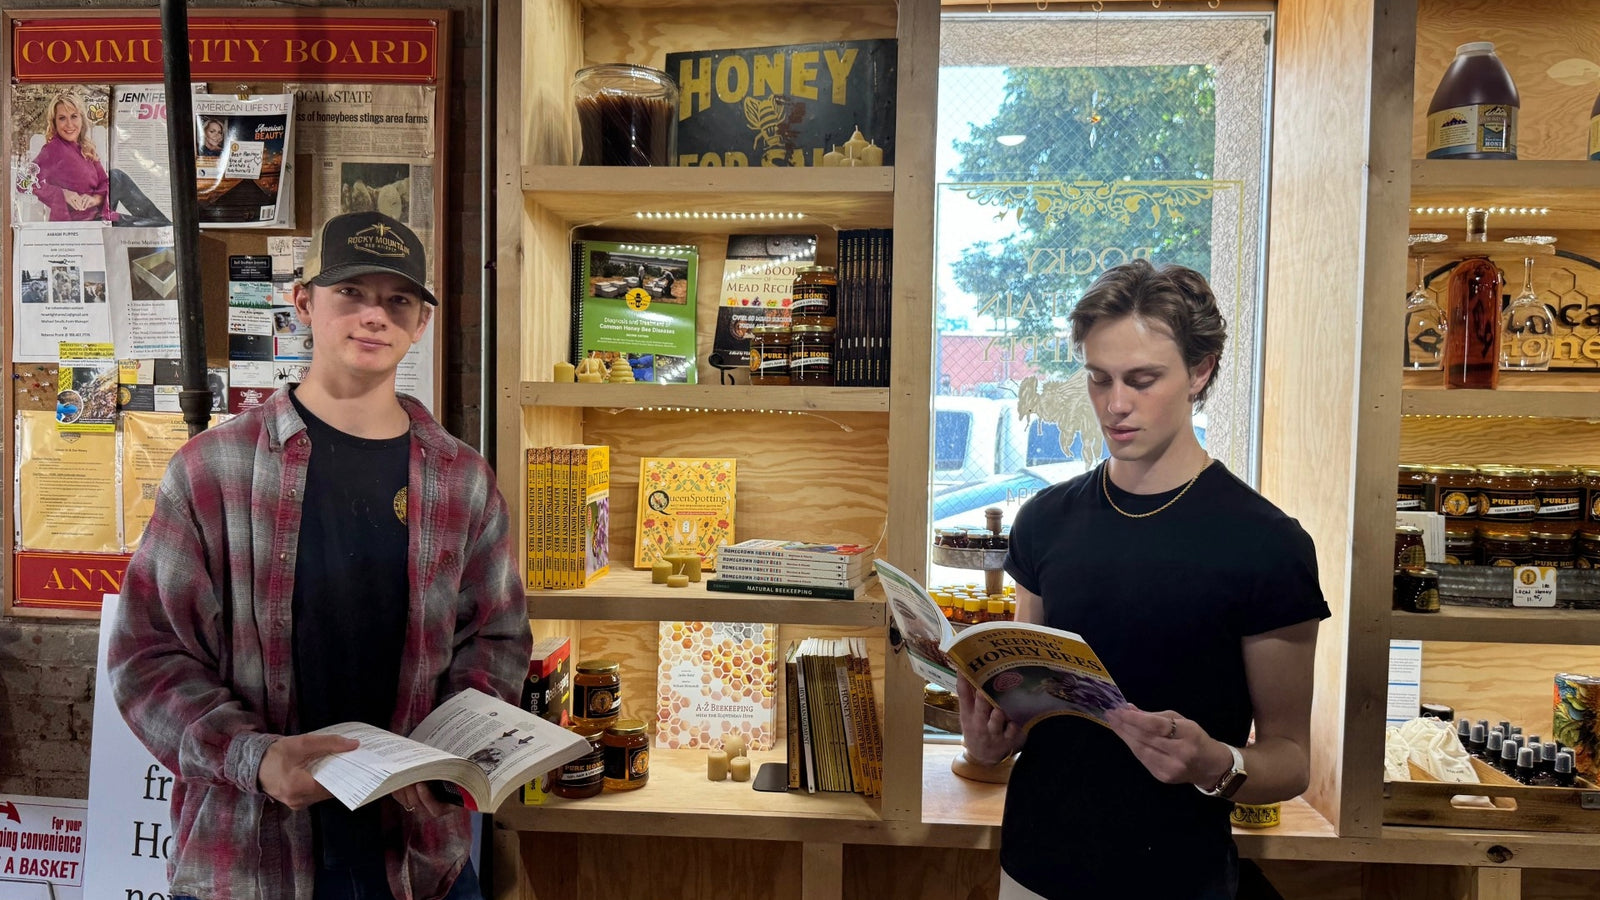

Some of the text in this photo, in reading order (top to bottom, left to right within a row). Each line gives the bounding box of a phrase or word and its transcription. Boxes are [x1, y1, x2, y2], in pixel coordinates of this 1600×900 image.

[284, 40, 428, 63] BOARD
[679, 48, 859, 122] HONEY
[119, 92, 166, 102] JENNIFE
[296, 90, 373, 103] OCAL&STATE
[196, 103, 289, 112] AMERICAN LIFESTYLE
[308, 112, 316, 122] of
[317, 112, 358, 124] honeybees
[360, 113, 384, 124] stings
[386, 115, 404, 123] area
[406, 113, 428, 124] farms
[255, 132, 284, 140] BEAUTY
[348, 236, 410, 256] ROCKY MOUNTAIN
[727, 282, 792, 294] MEAD RECI
[724, 548, 754, 556] HOMEGROWN
[722, 556, 753, 565] HOMEGROWN
[722, 565, 753, 574] HOMEGROWN
[43, 568, 124, 592] ANN
[722, 574, 753, 582] HOMEGROWN
[747, 584, 813, 596] NATURAL BEEKEEPING
[990, 637, 1061, 651] KEEPING
[967, 646, 1102, 674] HONEY BEES
[712, 704, 754, 713] BEEKEEPING
[841, 690, 851, 718] HONEY
[800, 702, 810, 745] MANAGEMENT
[52, 816, 82, 832] For your
[20, 832, 82, 854] convenience
[4, 856, 79, 879] A BASKET
